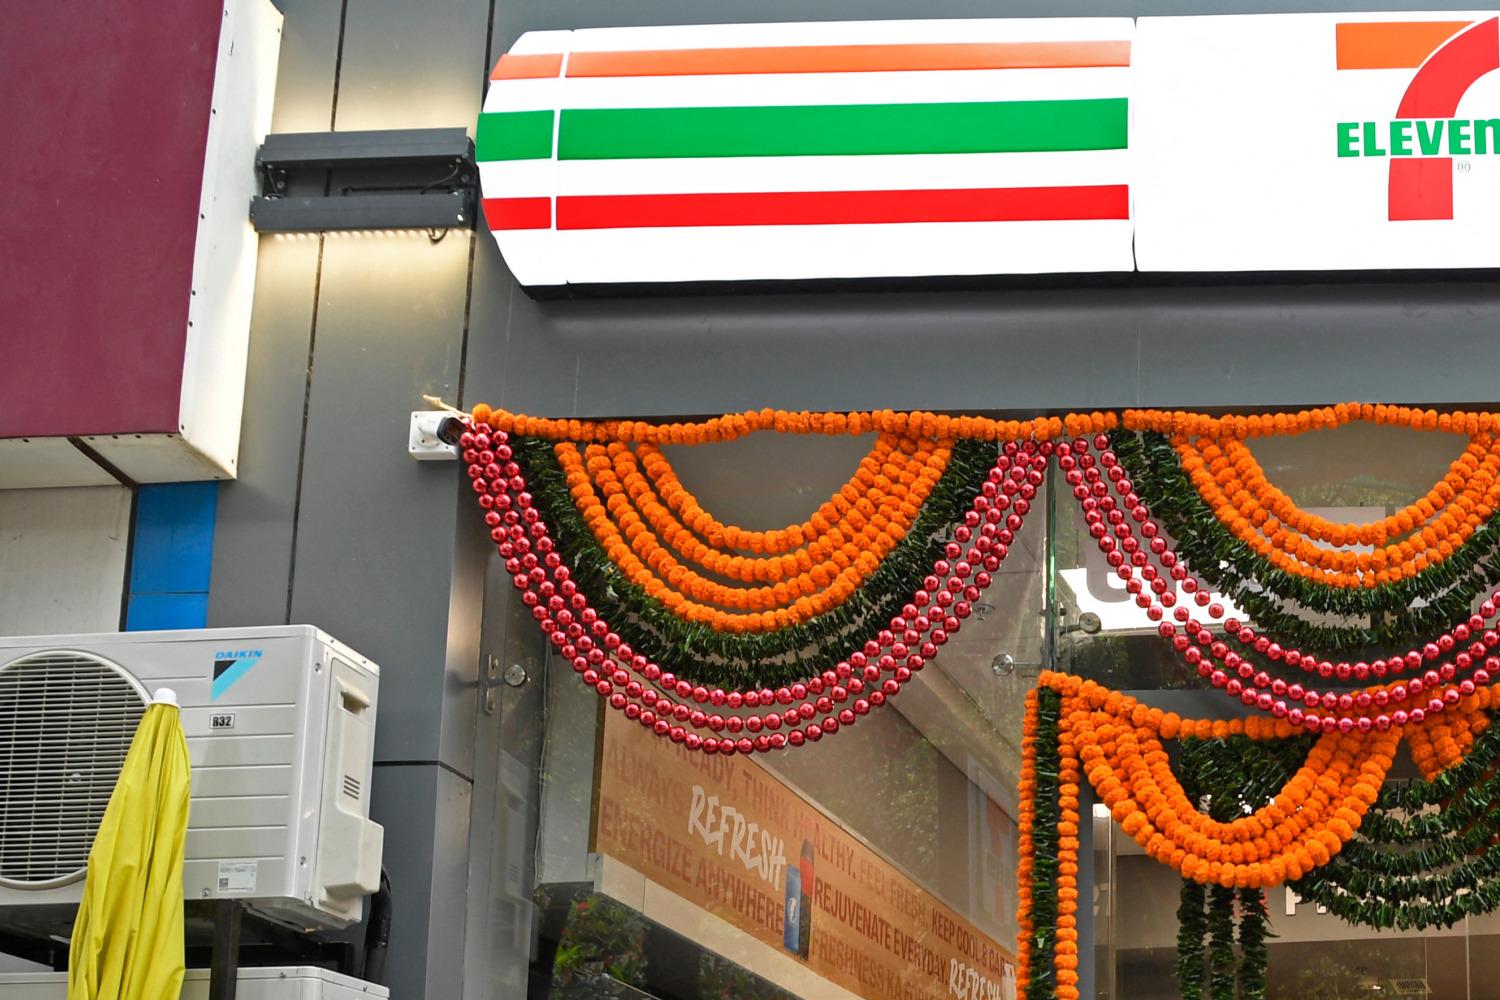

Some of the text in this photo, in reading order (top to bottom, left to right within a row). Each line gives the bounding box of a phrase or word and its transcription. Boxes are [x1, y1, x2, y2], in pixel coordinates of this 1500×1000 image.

[1336, 16, 1500, 221] 7
[215, 649, 263, 660] DAIKIN
[212, 716, 232, 728] R32
[600, 796, 786, 936] ENERGIZE ANYWHERE
[687, 785, 788, 891] REFRESH
[793, 808, 856, 880] HALTHY.
[931, 908, 956, 945] KEEP
[957, 928, 980, 963] COOL
[813, 876, 892, 950] REJUVENATE
[810, 927, 885, 990] FRESHNESS
